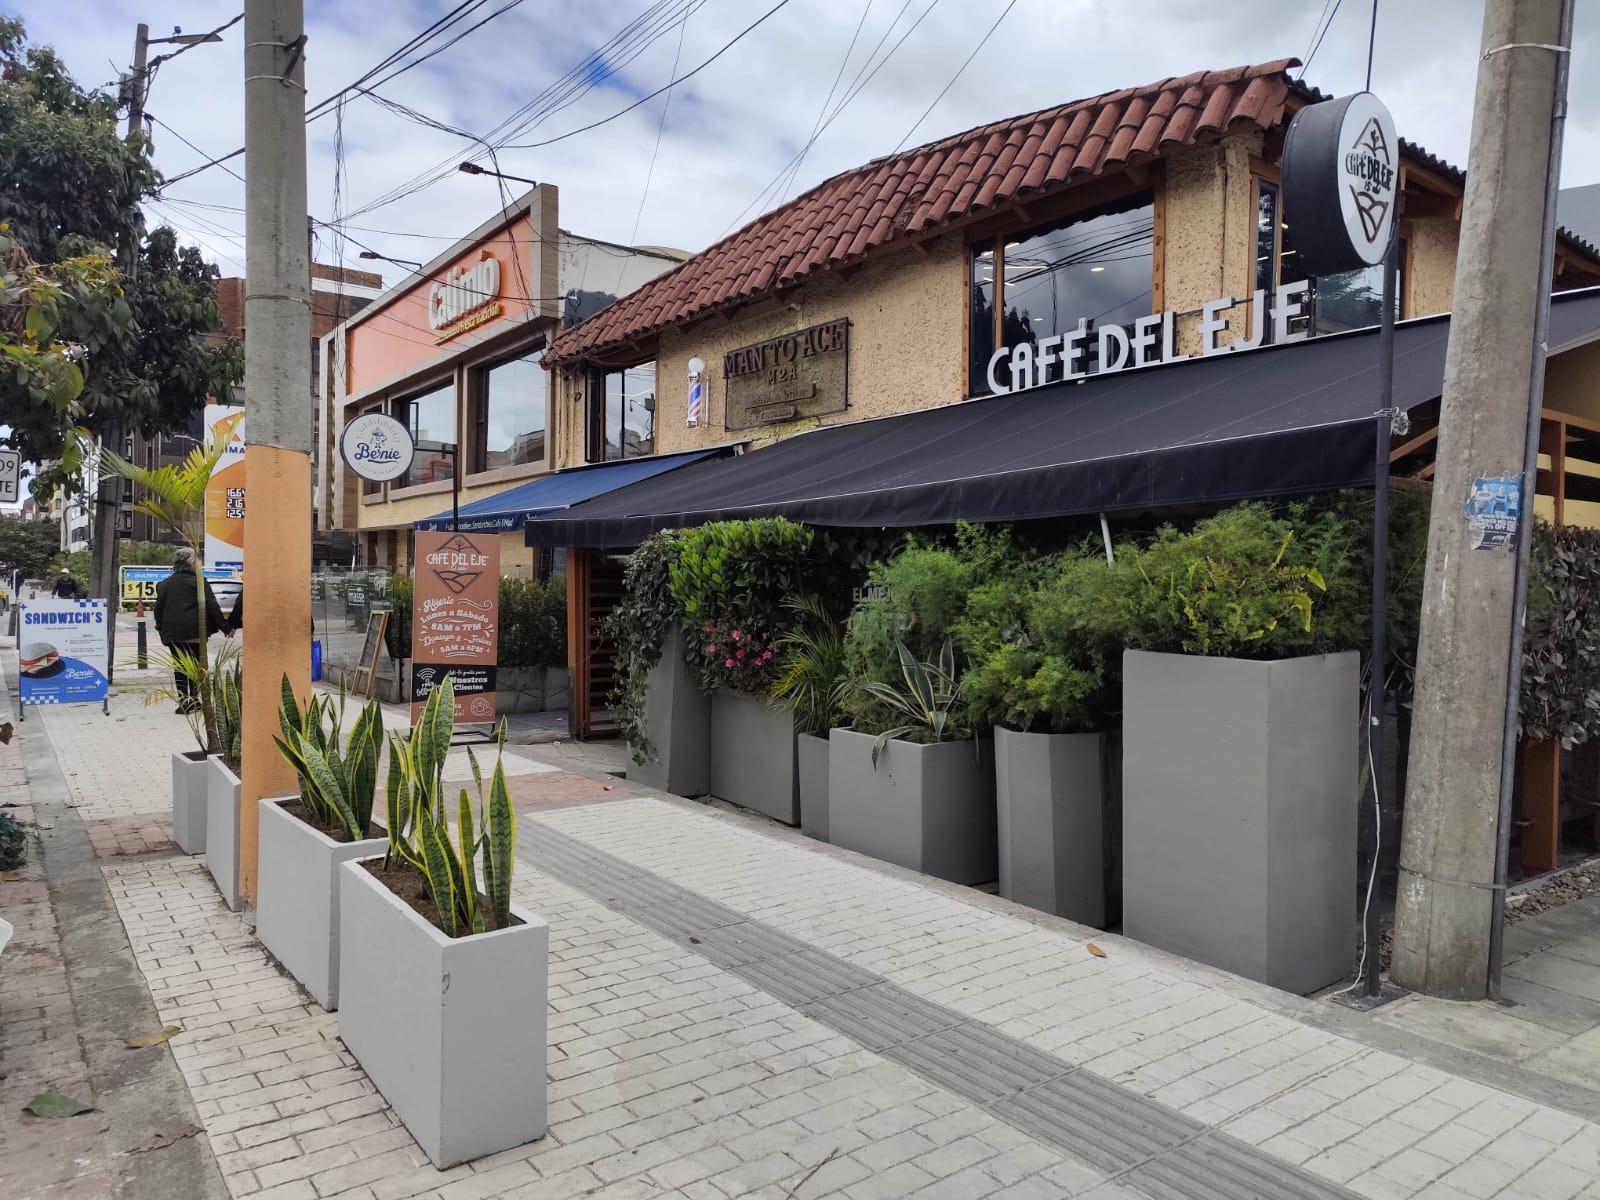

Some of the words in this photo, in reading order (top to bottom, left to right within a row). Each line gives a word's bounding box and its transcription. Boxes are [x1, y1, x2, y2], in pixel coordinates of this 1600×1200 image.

[986, 317, 1089, 396] CAFÉ
[1098, 311, 1190, 374] DEL
[1198, 279, 1310, 355] EJE
[354, 442, 402, 461] Bernie
[451, 553, 468, 566] DEL
[470, 554, 487, 566] EJE
[24, 611, 103, 625] SANDWICH'S
[420, 609, 447, 624] Lunes
